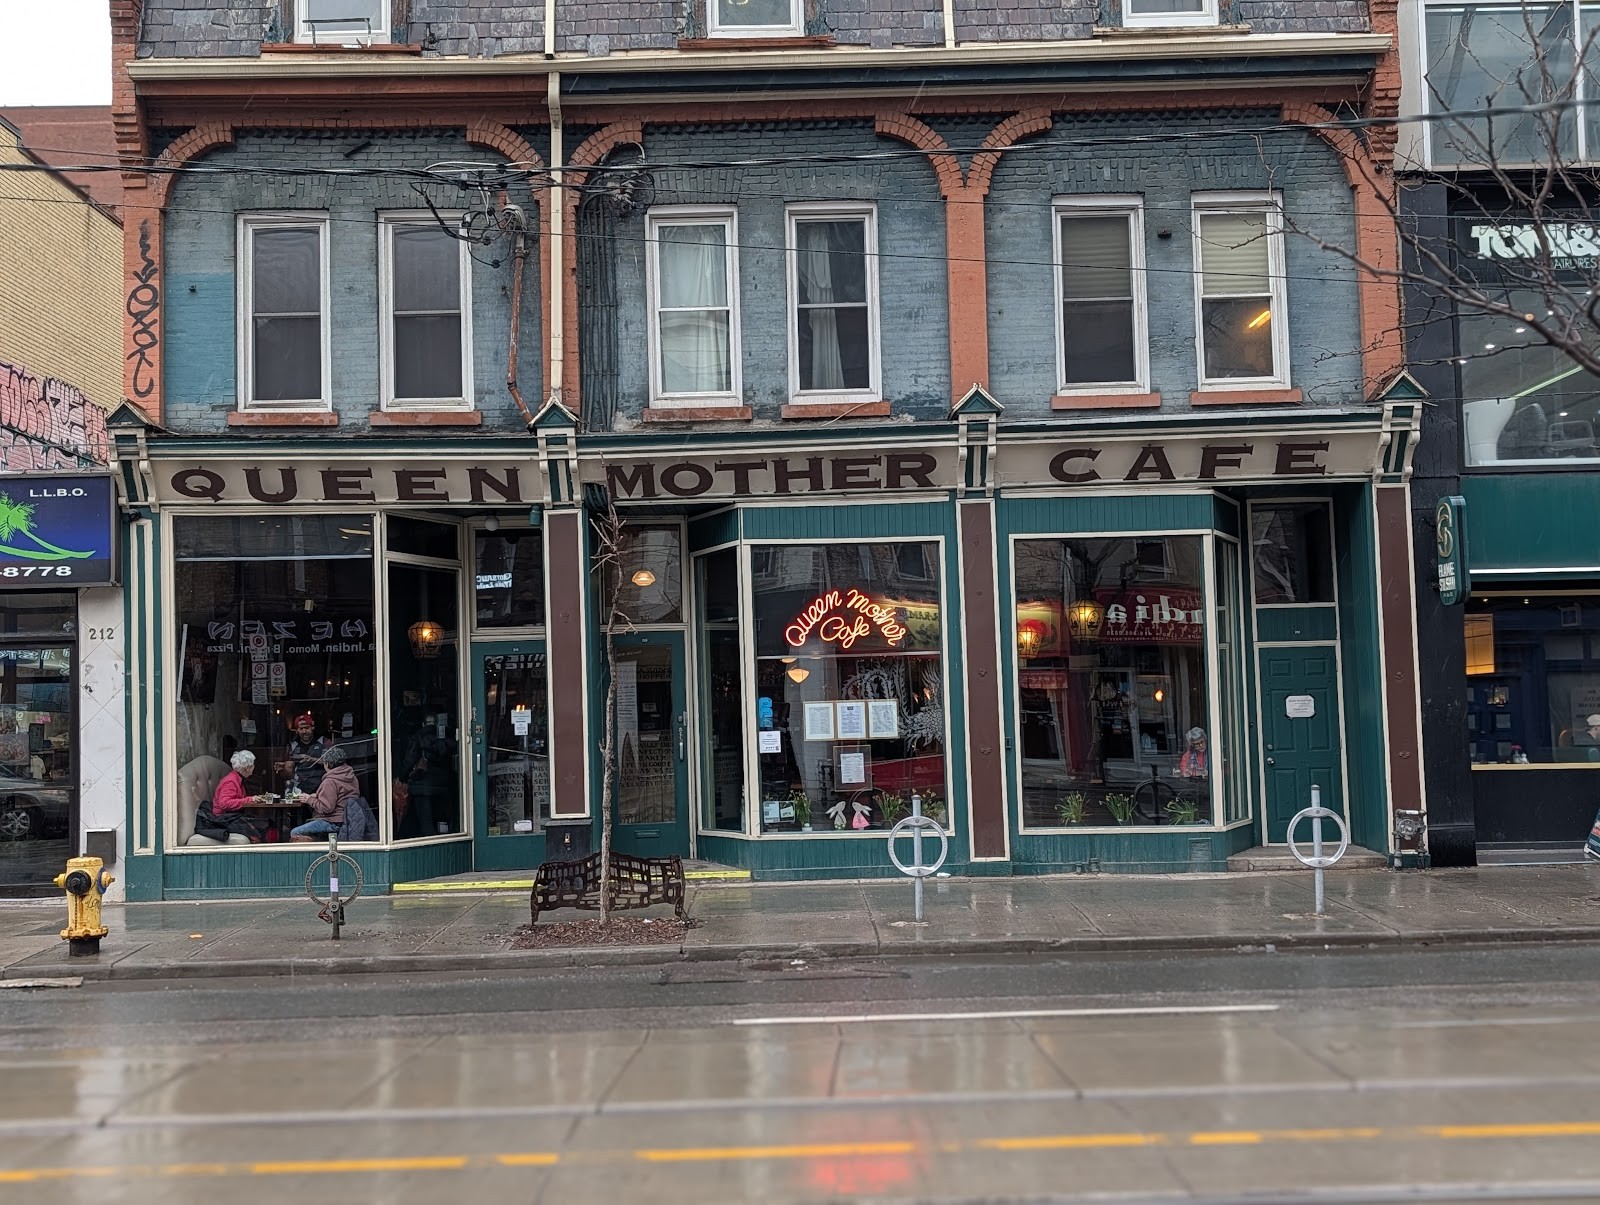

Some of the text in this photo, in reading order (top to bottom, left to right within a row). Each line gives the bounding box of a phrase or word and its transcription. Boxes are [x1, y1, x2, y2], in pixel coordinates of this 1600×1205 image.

[1471, 223, 1600, 259] TONI&
[605, 452, 938, 499] MOTHER
[1048, 441, 1330, 483] CAFE
[29, 487, 88, 498] L.L.B.O.
[171, 466, 523, 503] QUEEN
[89, 628, 115, 640] 212
[785, 590, 843, 647] Queen
[820, 615, 870, 648] Cafe
